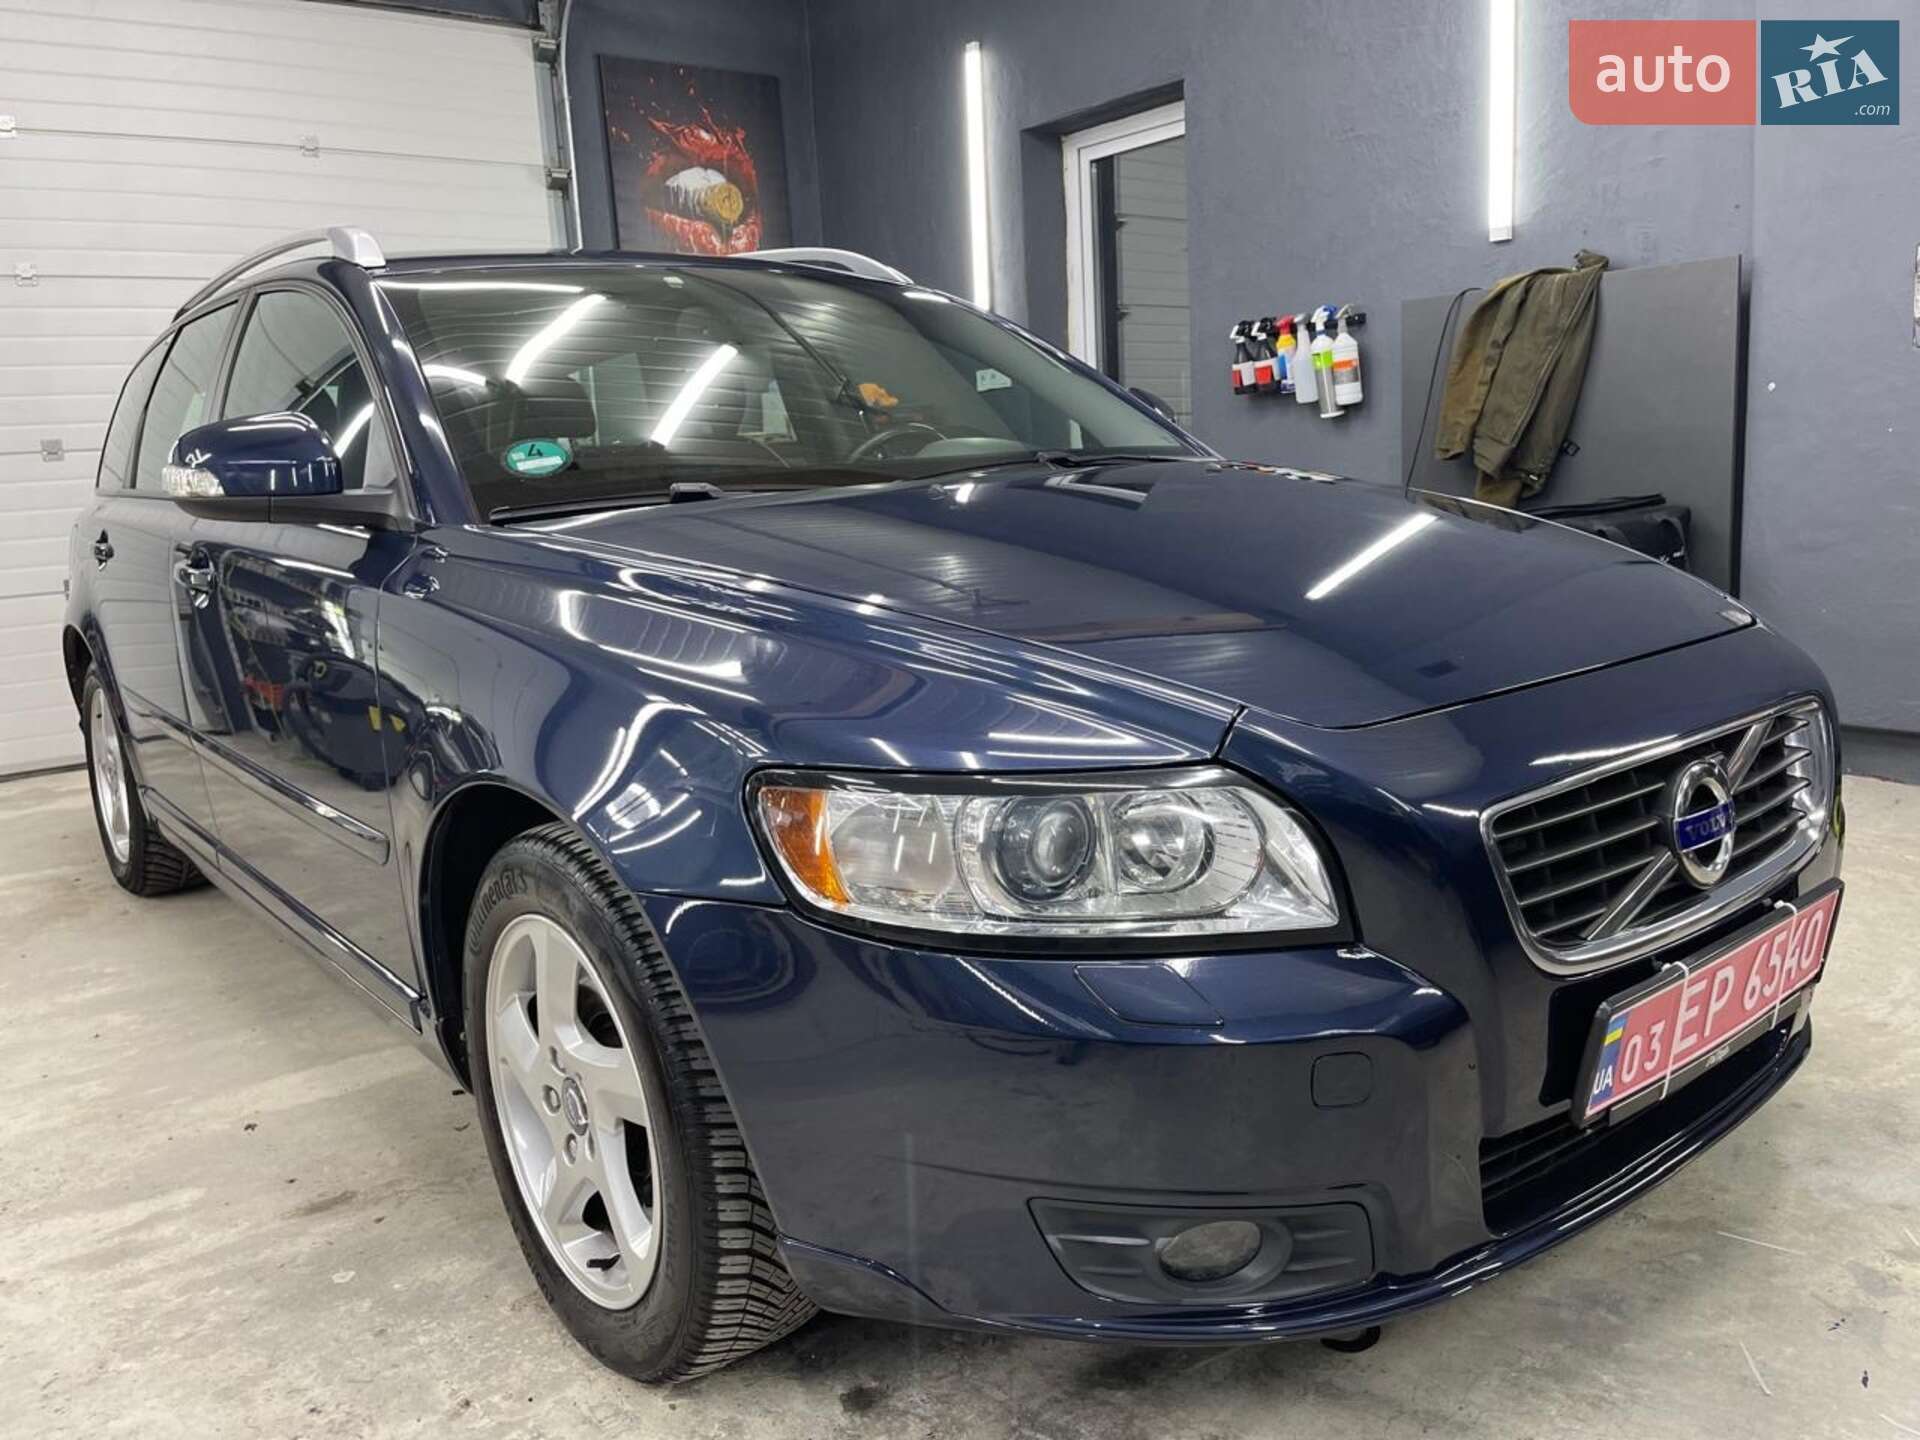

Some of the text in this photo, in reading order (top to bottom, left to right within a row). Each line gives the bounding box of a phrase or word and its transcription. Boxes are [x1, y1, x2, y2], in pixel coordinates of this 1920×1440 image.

[528, 444, 543, 456] 4
[1685, 812, 1728, 841] VOLV
[1621, 910, 1824, 1083] 03 EP 6540
[1593, 1065, 1613, 1094] UA
